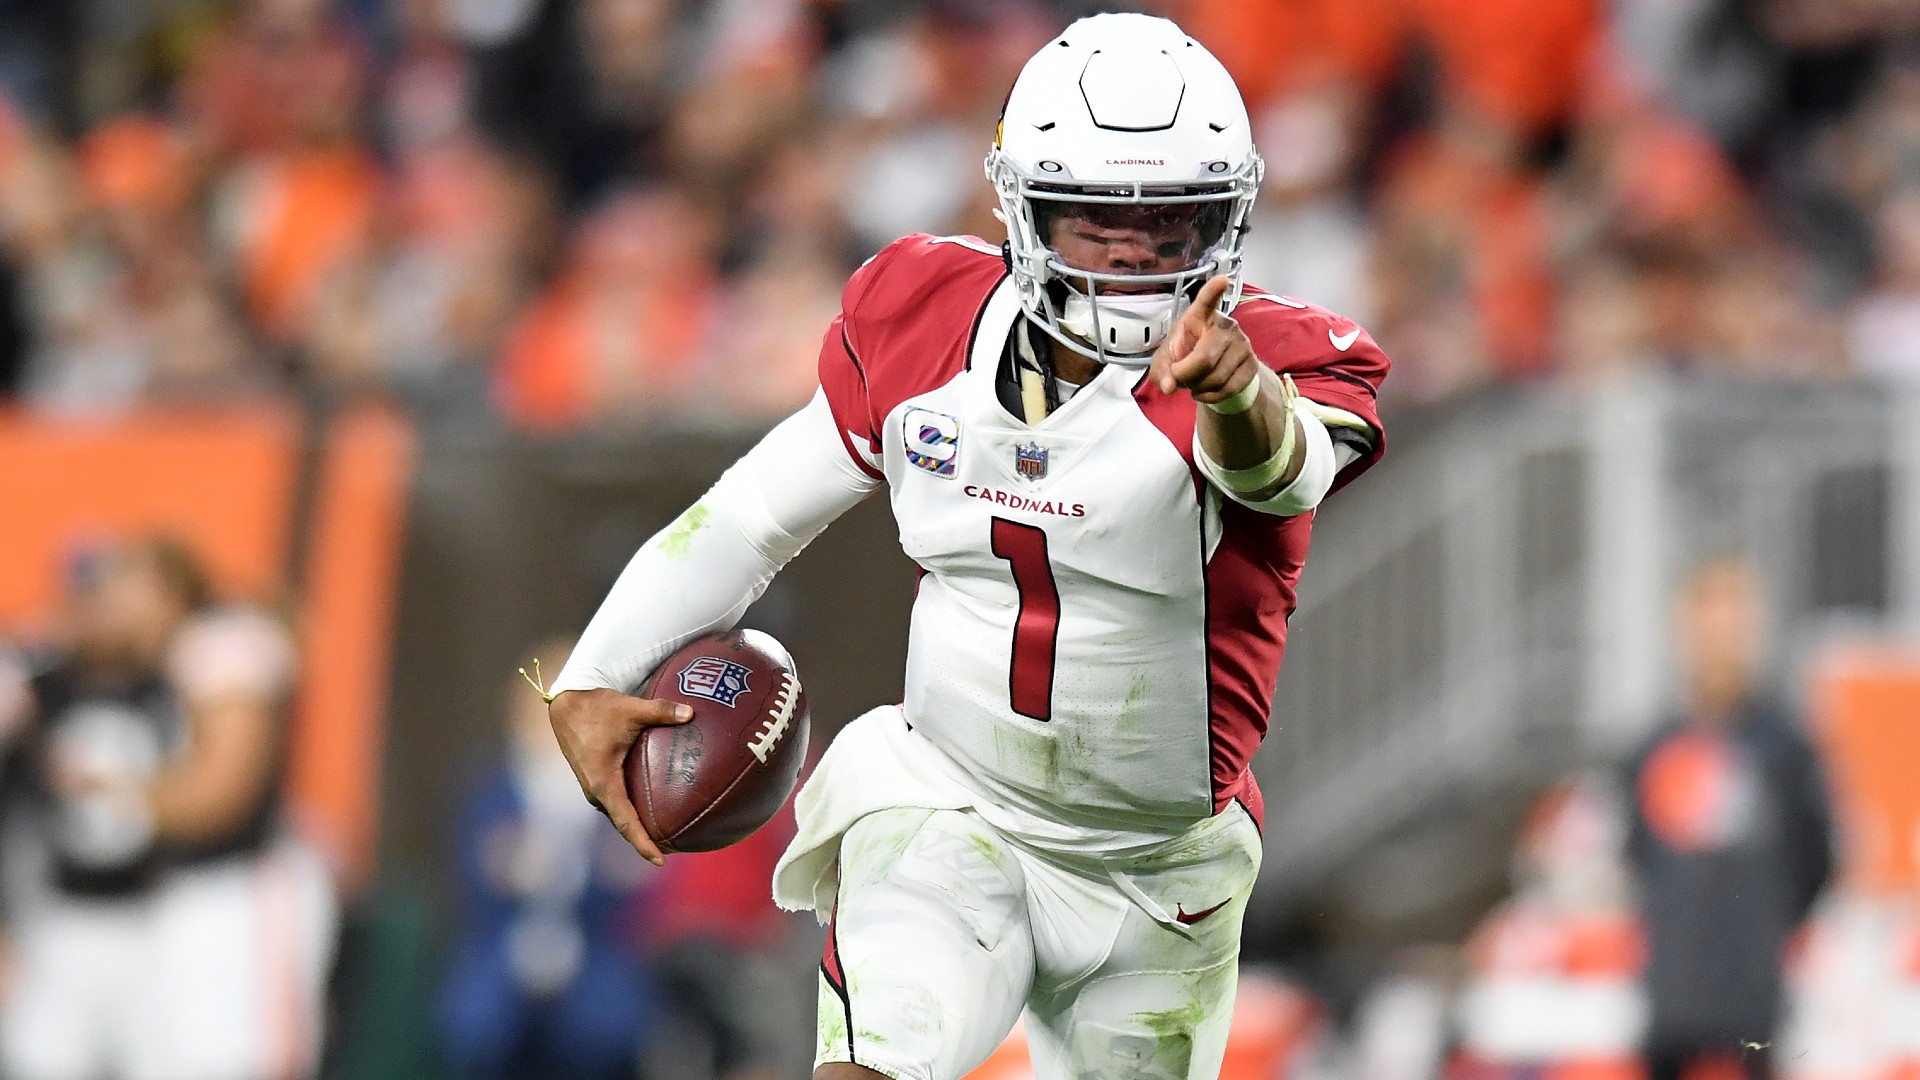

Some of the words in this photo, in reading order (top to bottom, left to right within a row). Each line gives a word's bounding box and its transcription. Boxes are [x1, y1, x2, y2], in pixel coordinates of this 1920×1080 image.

[1105, 158, 1165, 166] CARDINALS
[904, 409, 957, 461] C
[1020, 459, 1045, 475] NFL
[964, 485, 1085, 518] CARDINALS
[991, 516, 1061, 722] 1
[687, 660, 725, 690] NFL
